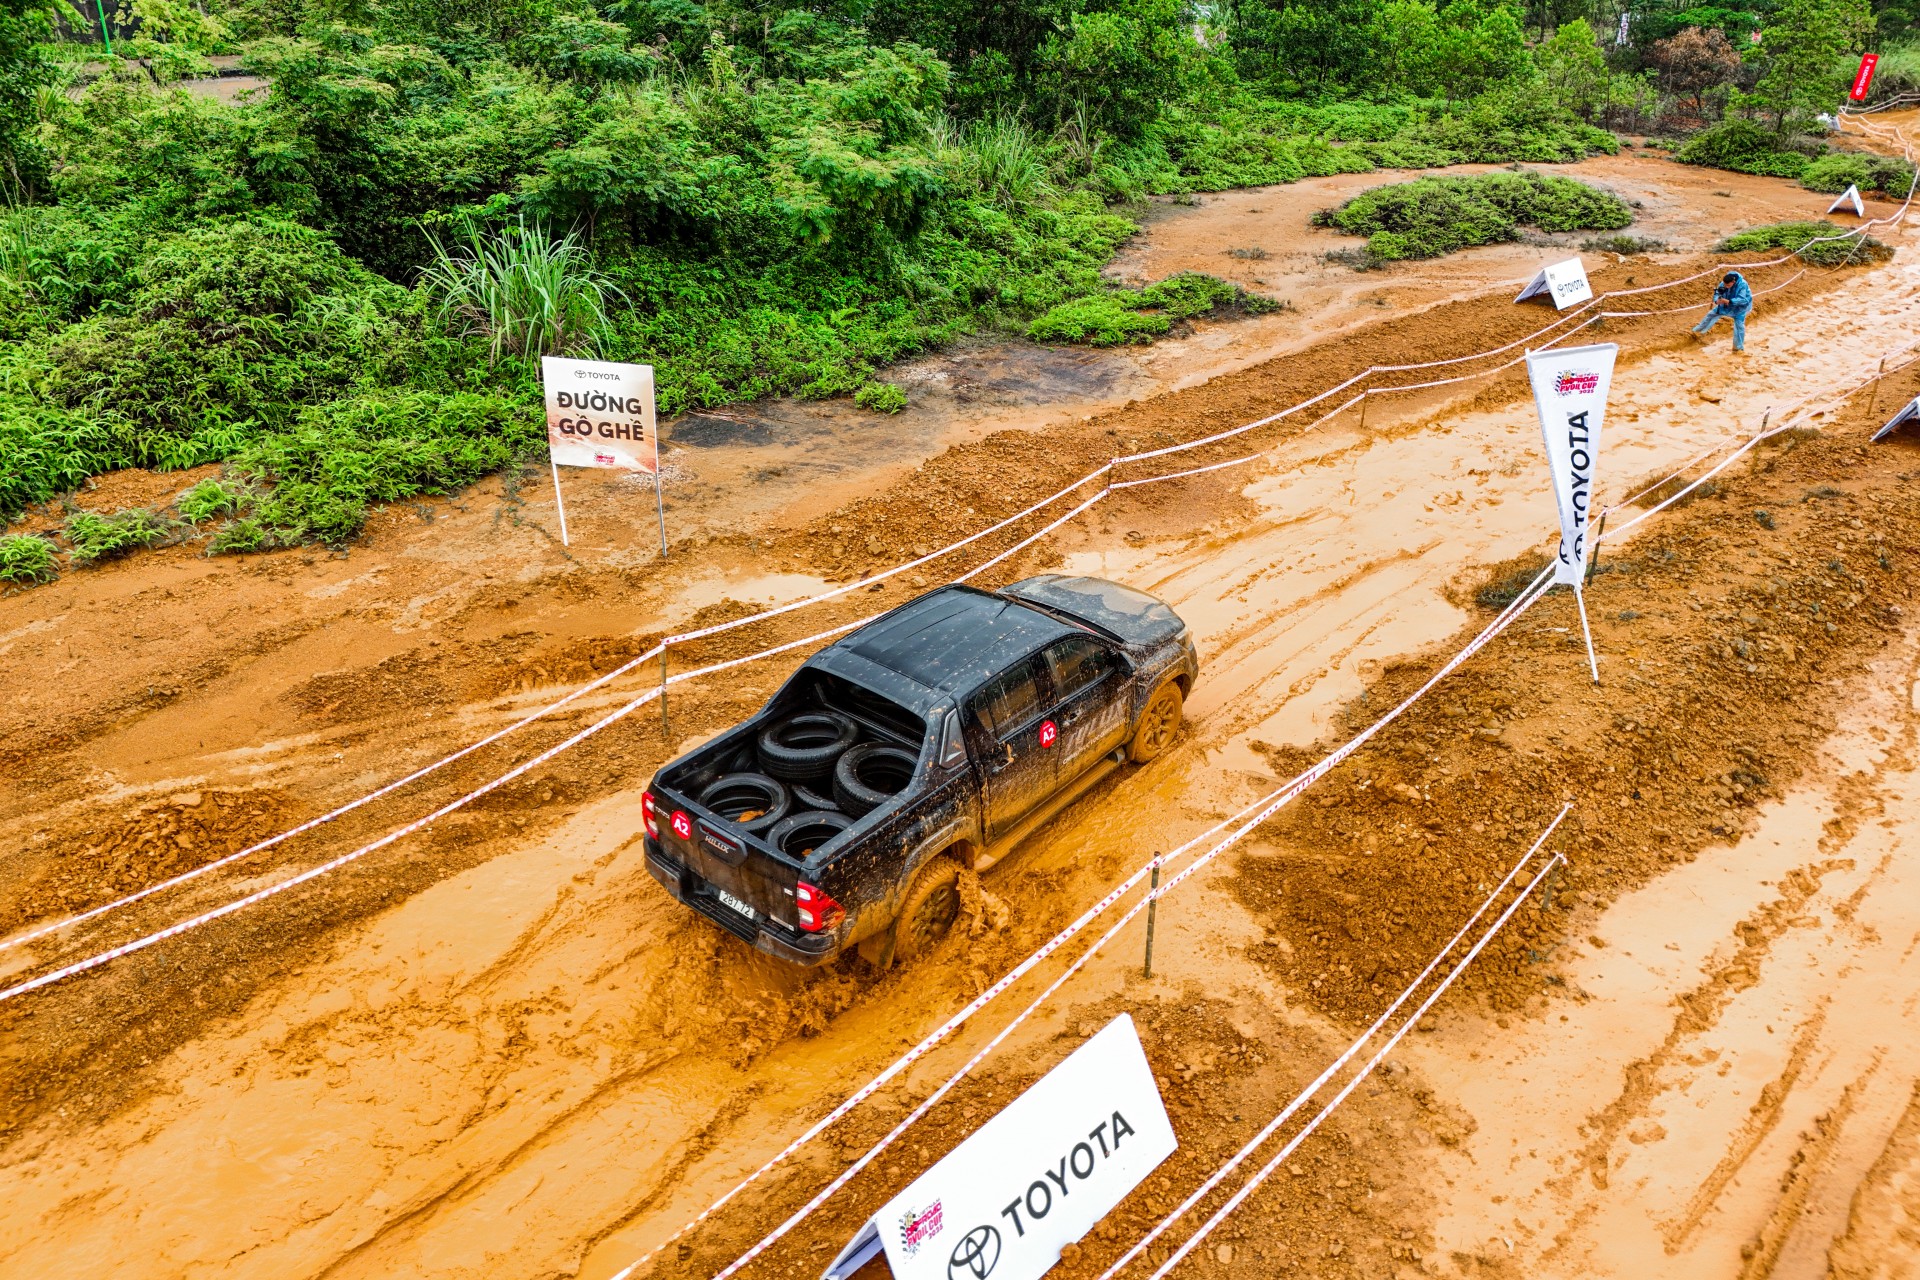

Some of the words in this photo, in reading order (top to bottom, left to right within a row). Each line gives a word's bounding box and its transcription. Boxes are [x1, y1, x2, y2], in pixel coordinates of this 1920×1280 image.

[1564, 279, 1584, 293] TOYOTA
[587, 371, 621, 381] TOYOTA
[1582, 381, 1598, 390] CUP
[556, 389, 643, 416] ĐƯỜNG
[558, 413, 593, 437] GỒ
[597, 418, 645, 442] GHỀ
[1568, 410, 1591, 528] TOYOTA
[1043, 727, 1055, 744] A2
[673, 818, 689, 836] A2
[705, 835, 730, 854] HILUX
[1000, 1110, 1135, 1237] TOYOTA
[907, 1225, 928, 1249] PVOIL
[928, 1211, 943, 1231] CUP
[928, 1223, 943, 1240] 2025
